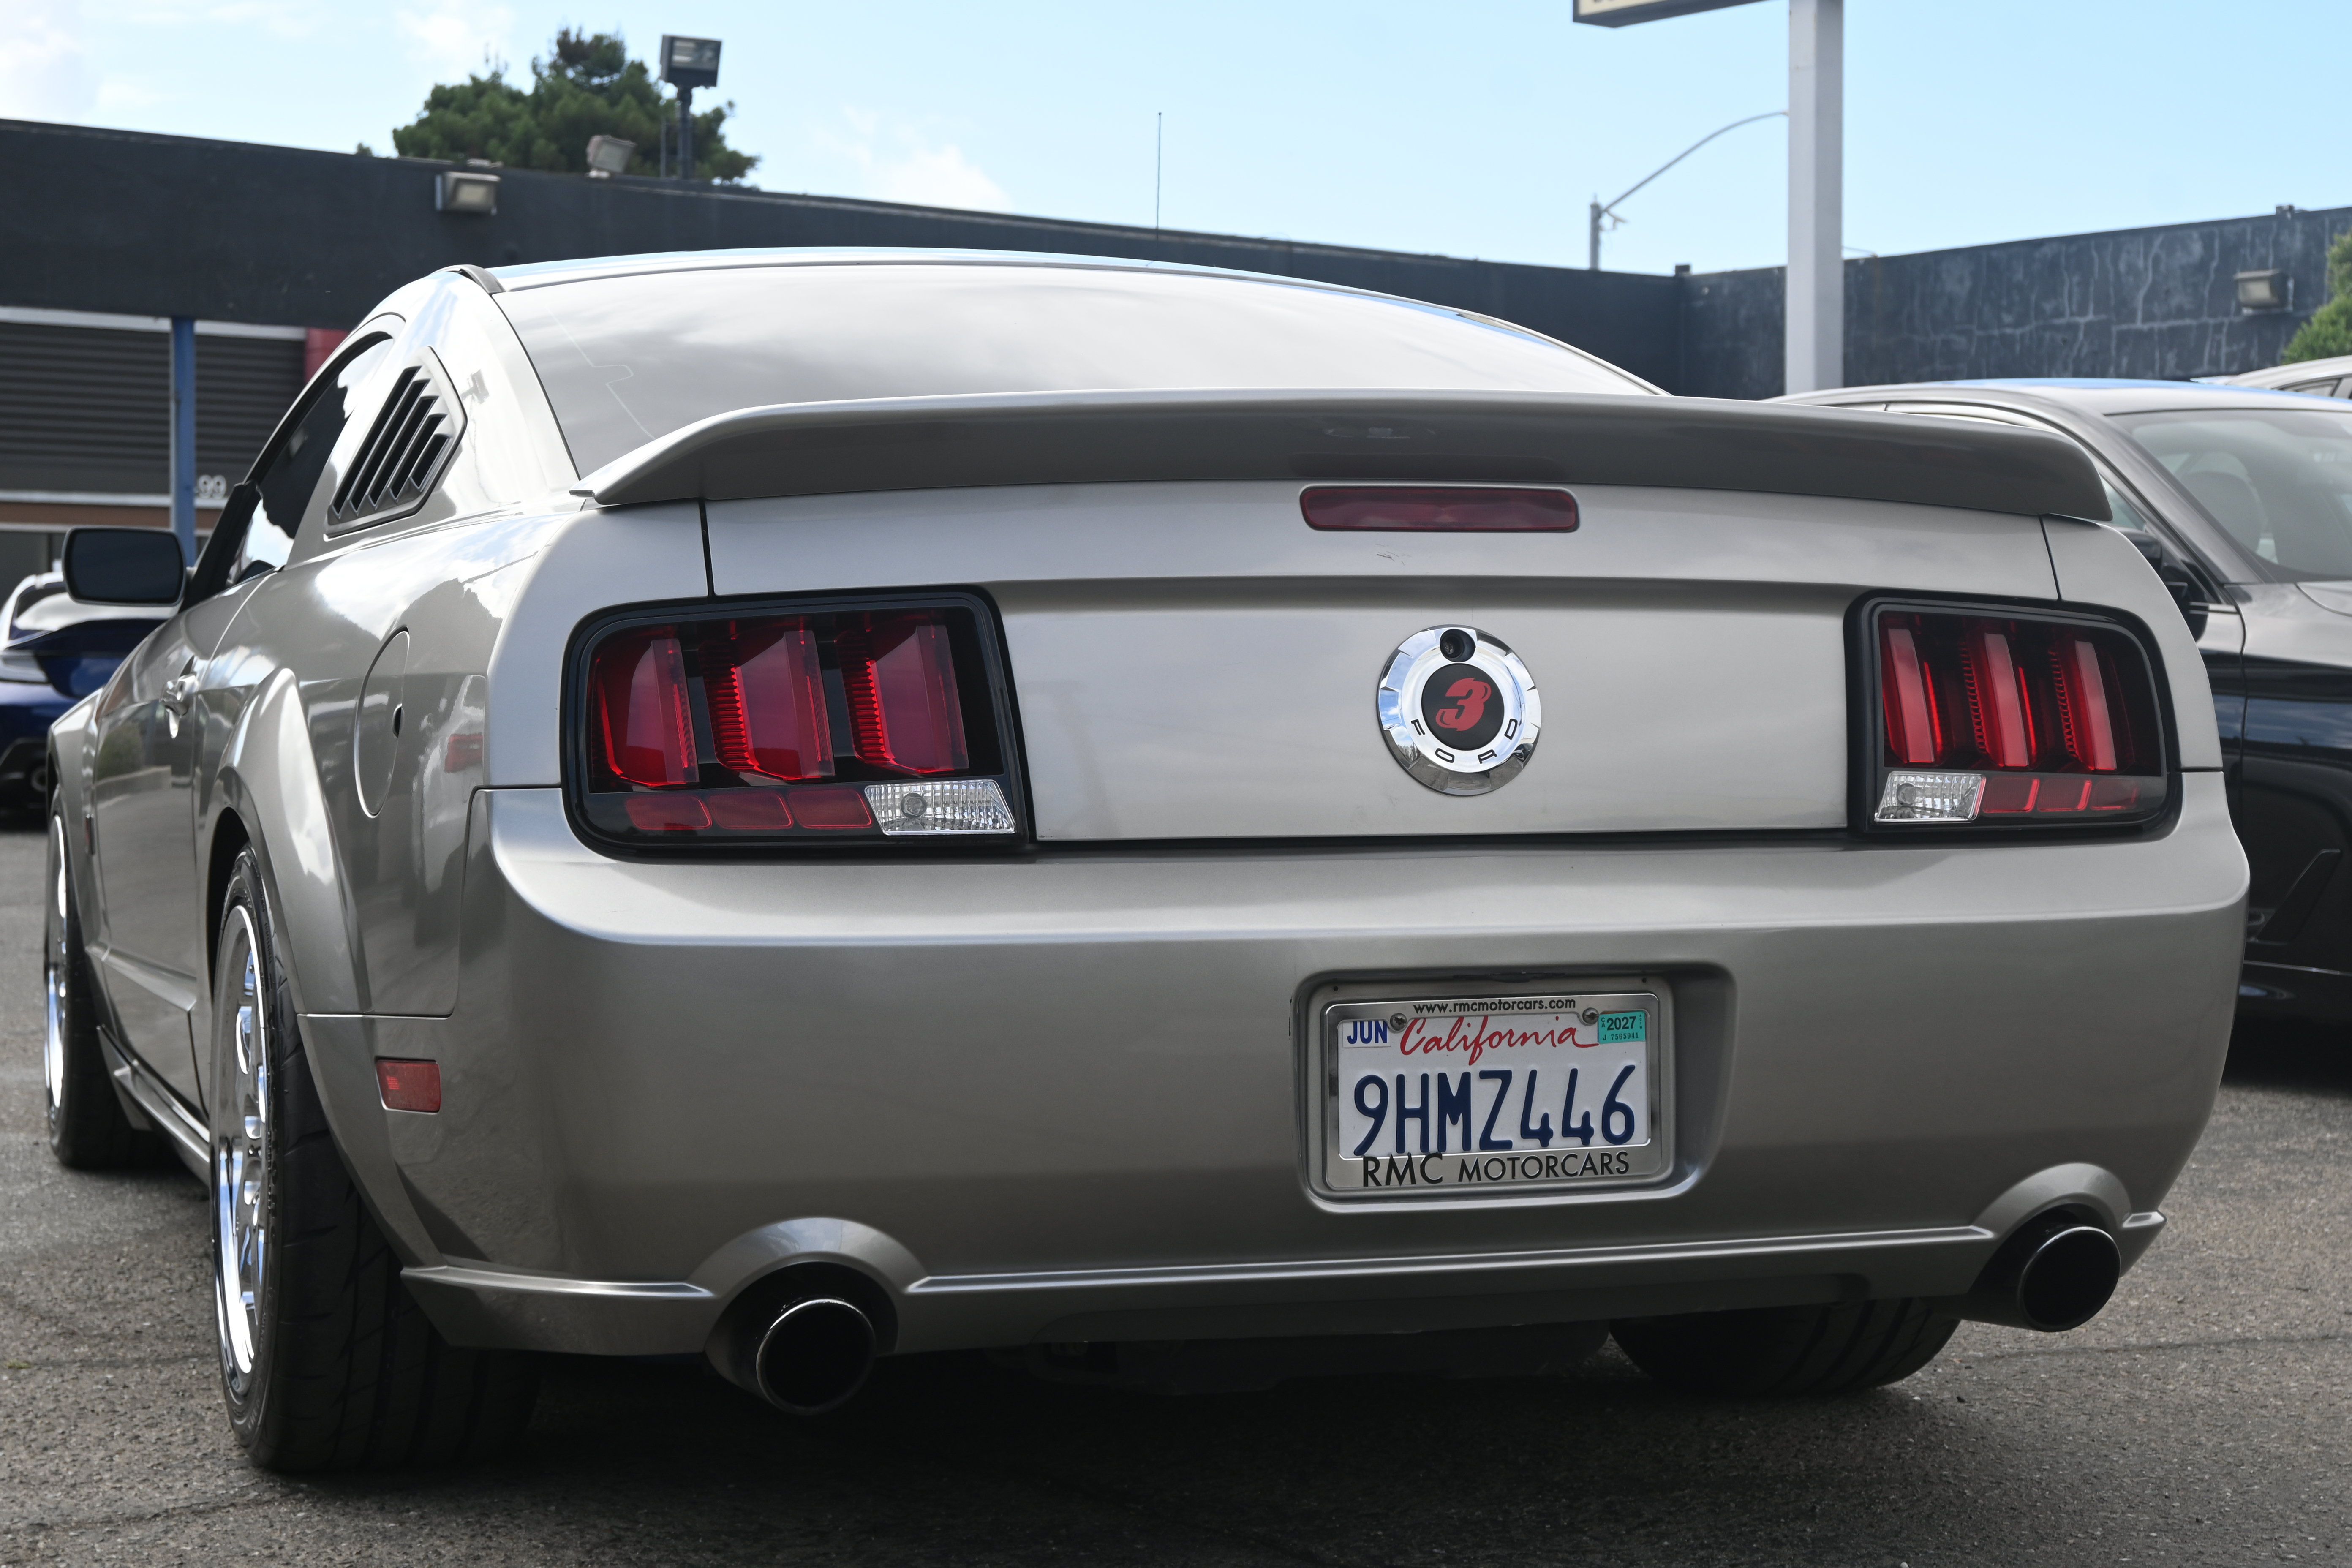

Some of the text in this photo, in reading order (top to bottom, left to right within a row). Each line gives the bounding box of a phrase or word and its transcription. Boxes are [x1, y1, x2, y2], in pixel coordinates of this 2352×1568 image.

[1411, 719, 1518, 764] FORD
[1413, 998, 1576, 1014] www.rmcmotorcars.com
[1607, 1016, 1637, 1031] 2027
[1347, 1021, 1388, 1044] JUN
[1400, 1016, 1599, 1066] California
[1353, 1064, 1636, 1156] 9HMZ446
[1362, 1150, 1630, 1187] RMC MOTORCARS
